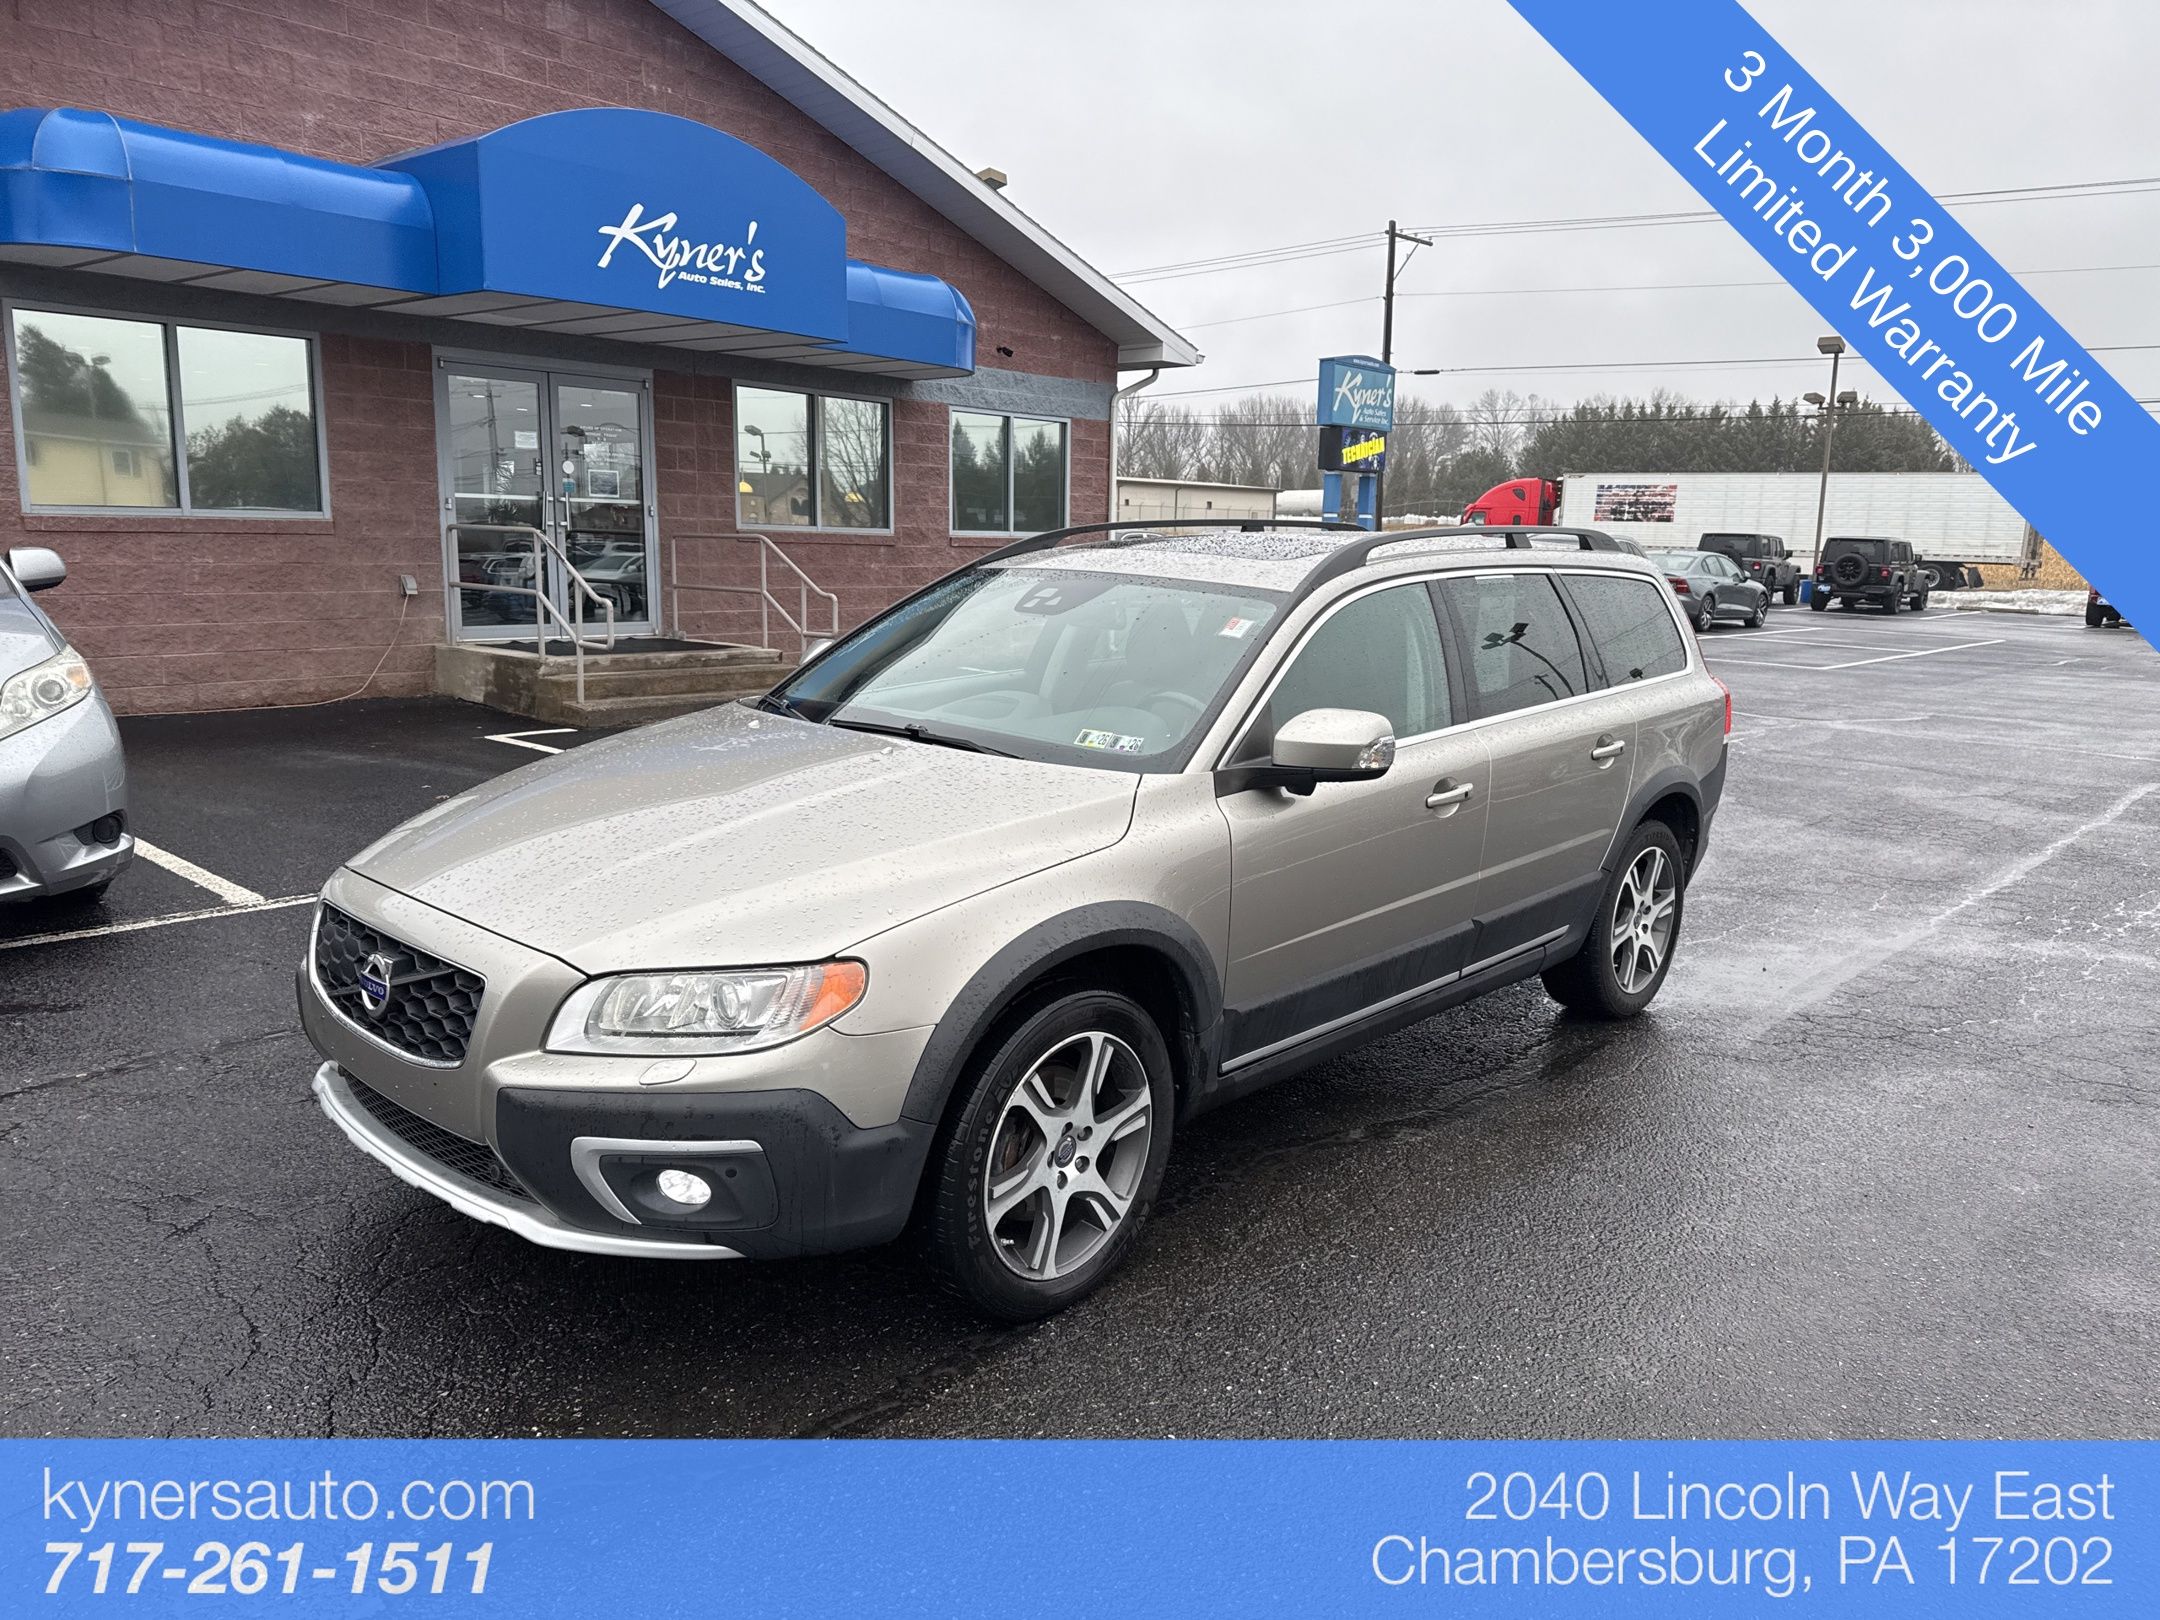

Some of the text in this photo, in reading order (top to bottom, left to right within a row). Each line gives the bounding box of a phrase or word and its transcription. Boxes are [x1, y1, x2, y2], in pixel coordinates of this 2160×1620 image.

[597, 203, 766, 290] Kyner's
[678, 271, 766, 294] Auto Sales, Inc.
[1333, 370, 1392, 424] Kyner's
[1342, 436, 1385, 465] TECHNICIAN
